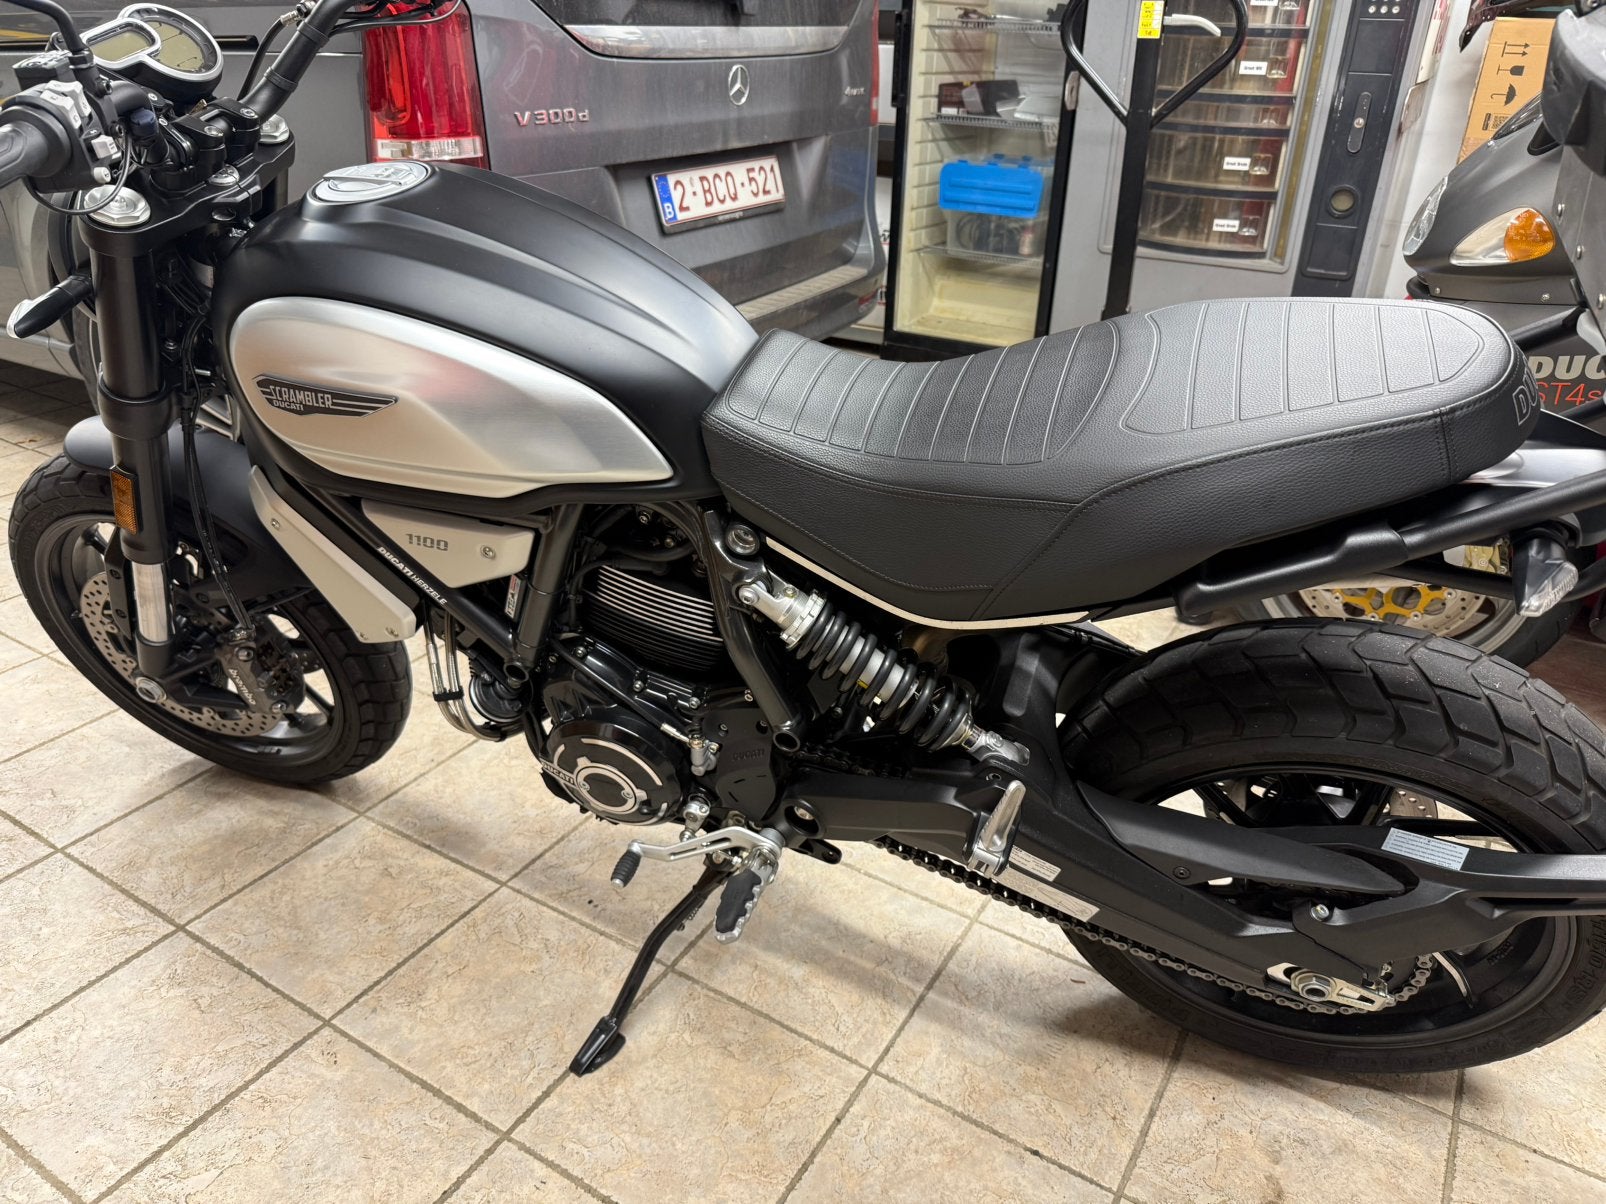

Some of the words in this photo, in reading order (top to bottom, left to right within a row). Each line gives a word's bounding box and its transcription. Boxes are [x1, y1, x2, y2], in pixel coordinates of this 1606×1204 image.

[663, 203, 675, 219] B
[269, 385, 333, 409] SCRAMBLER
[273, 399, 304, 412] DUCATI
[405, 533, 449, 551] 1100
